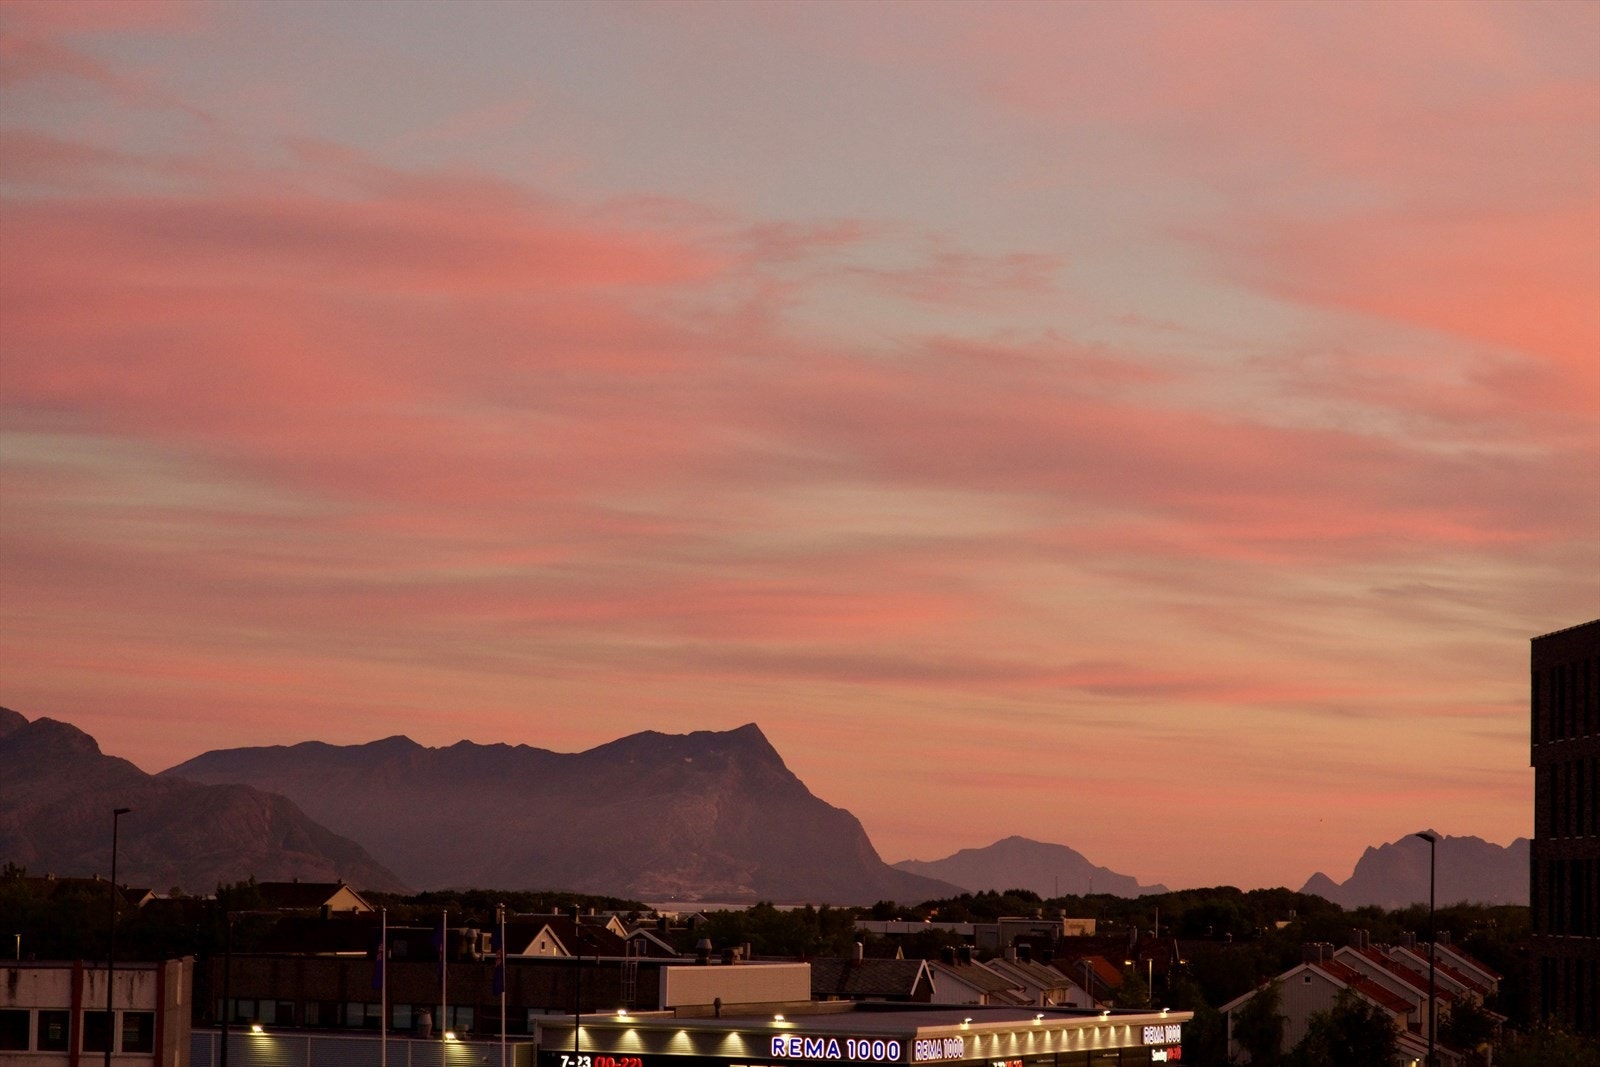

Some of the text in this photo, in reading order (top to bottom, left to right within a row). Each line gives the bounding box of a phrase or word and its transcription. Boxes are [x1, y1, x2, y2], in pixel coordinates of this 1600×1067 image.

[1143, 1024, 1181, 1045] REMA 1000
[771, 1036, 901, 1061] REMA 1000
[915, 1038, 964, 1061] REMA 1000
